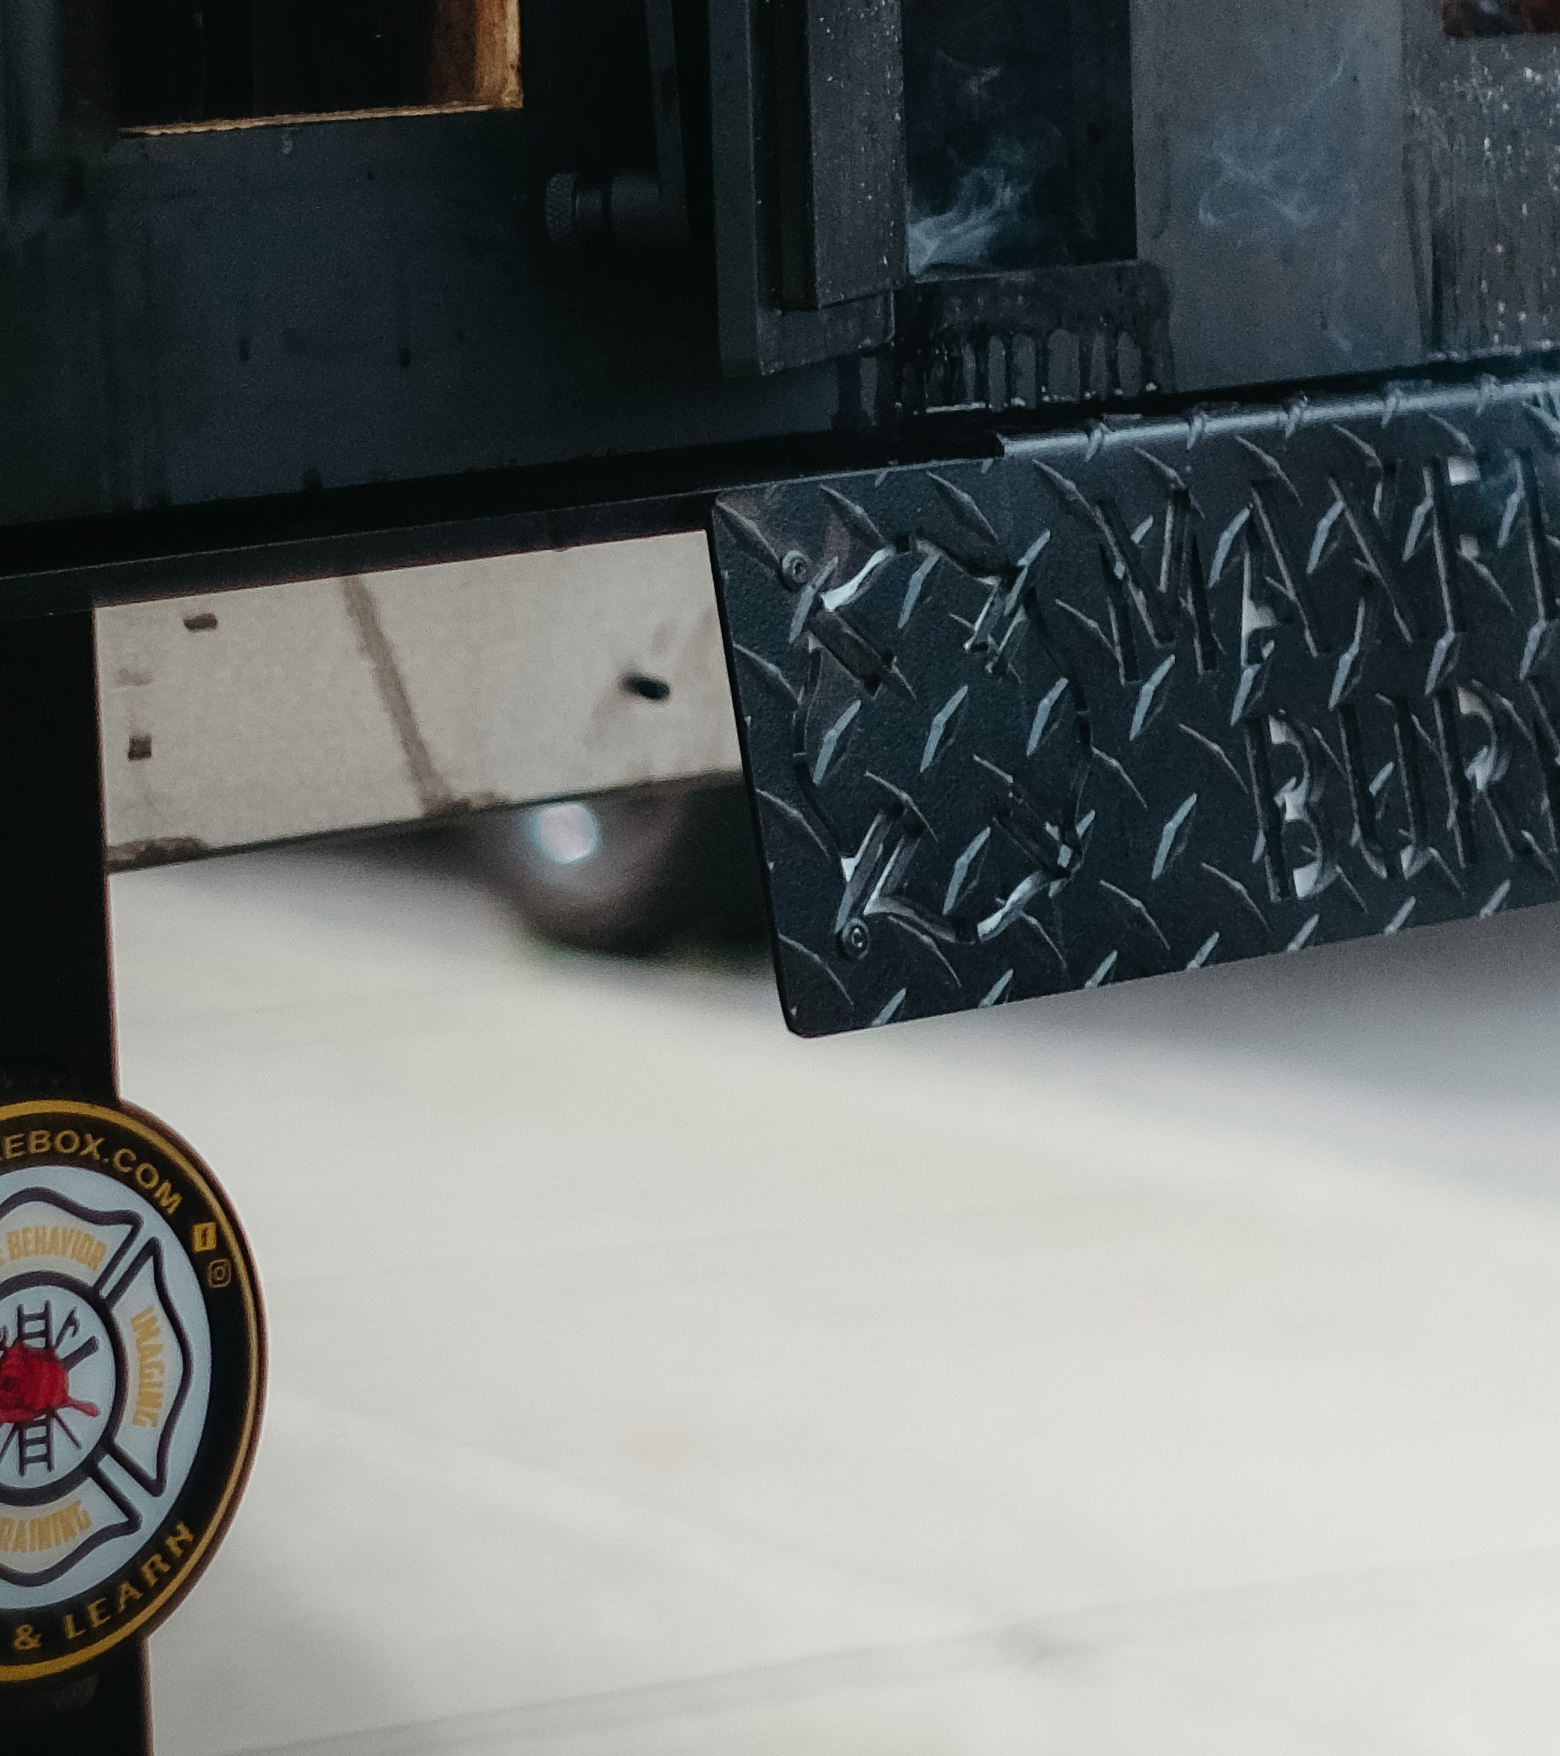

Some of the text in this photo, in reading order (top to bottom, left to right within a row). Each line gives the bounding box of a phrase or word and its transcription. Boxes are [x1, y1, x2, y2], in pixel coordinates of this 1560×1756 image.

[0, 1129, 183, 1216] EBOX.COM
[0, 1500, 93, 1554] RAINING
[13, 1521, 195, 1651] & LEARN
